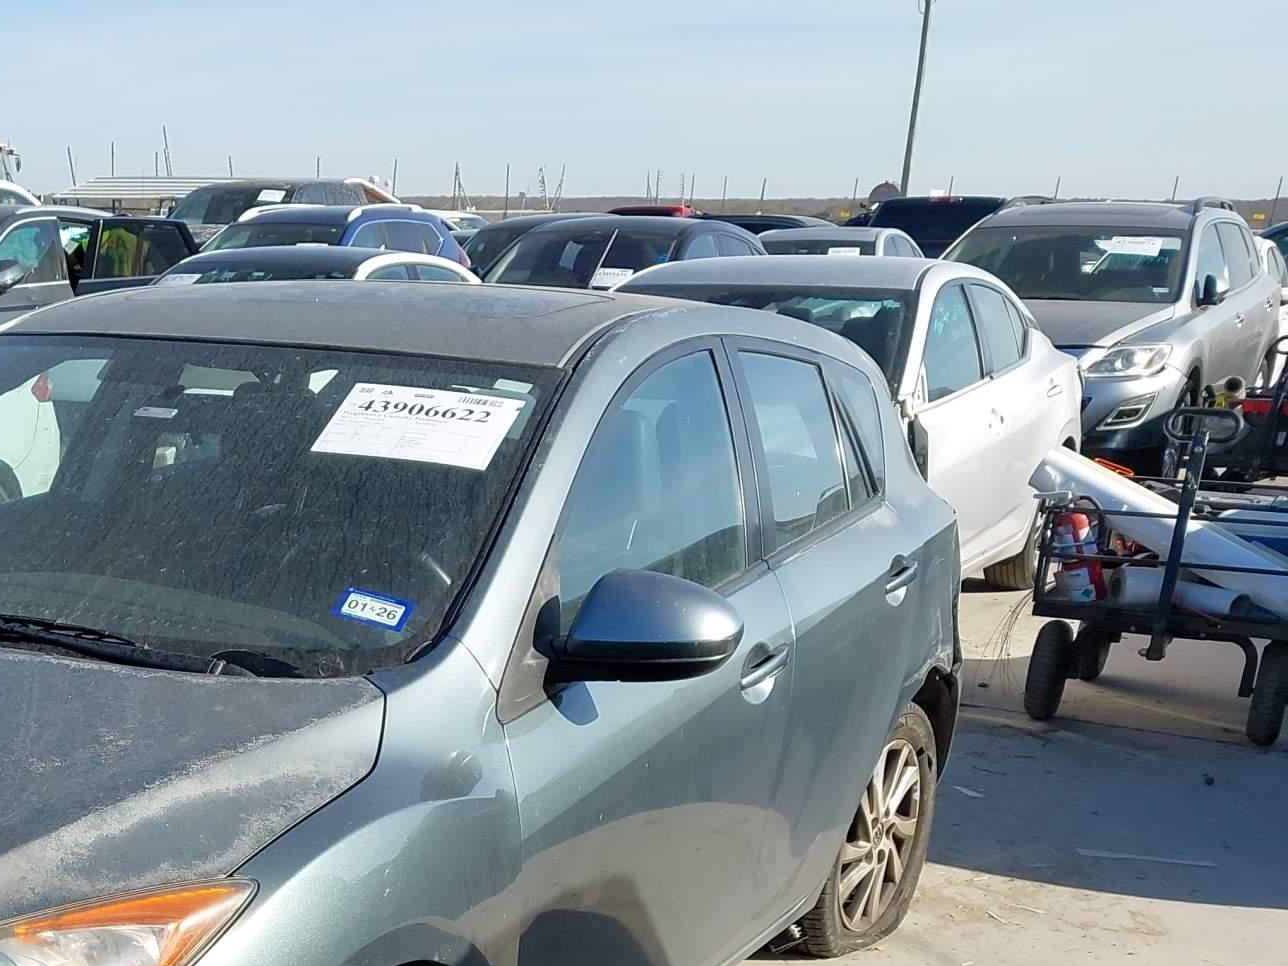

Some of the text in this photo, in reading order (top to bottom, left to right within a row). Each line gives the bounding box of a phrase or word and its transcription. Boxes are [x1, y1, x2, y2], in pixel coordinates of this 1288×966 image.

[357, 399, 492, 423] 43906622
[347, 599, 398, 620] 01 26
